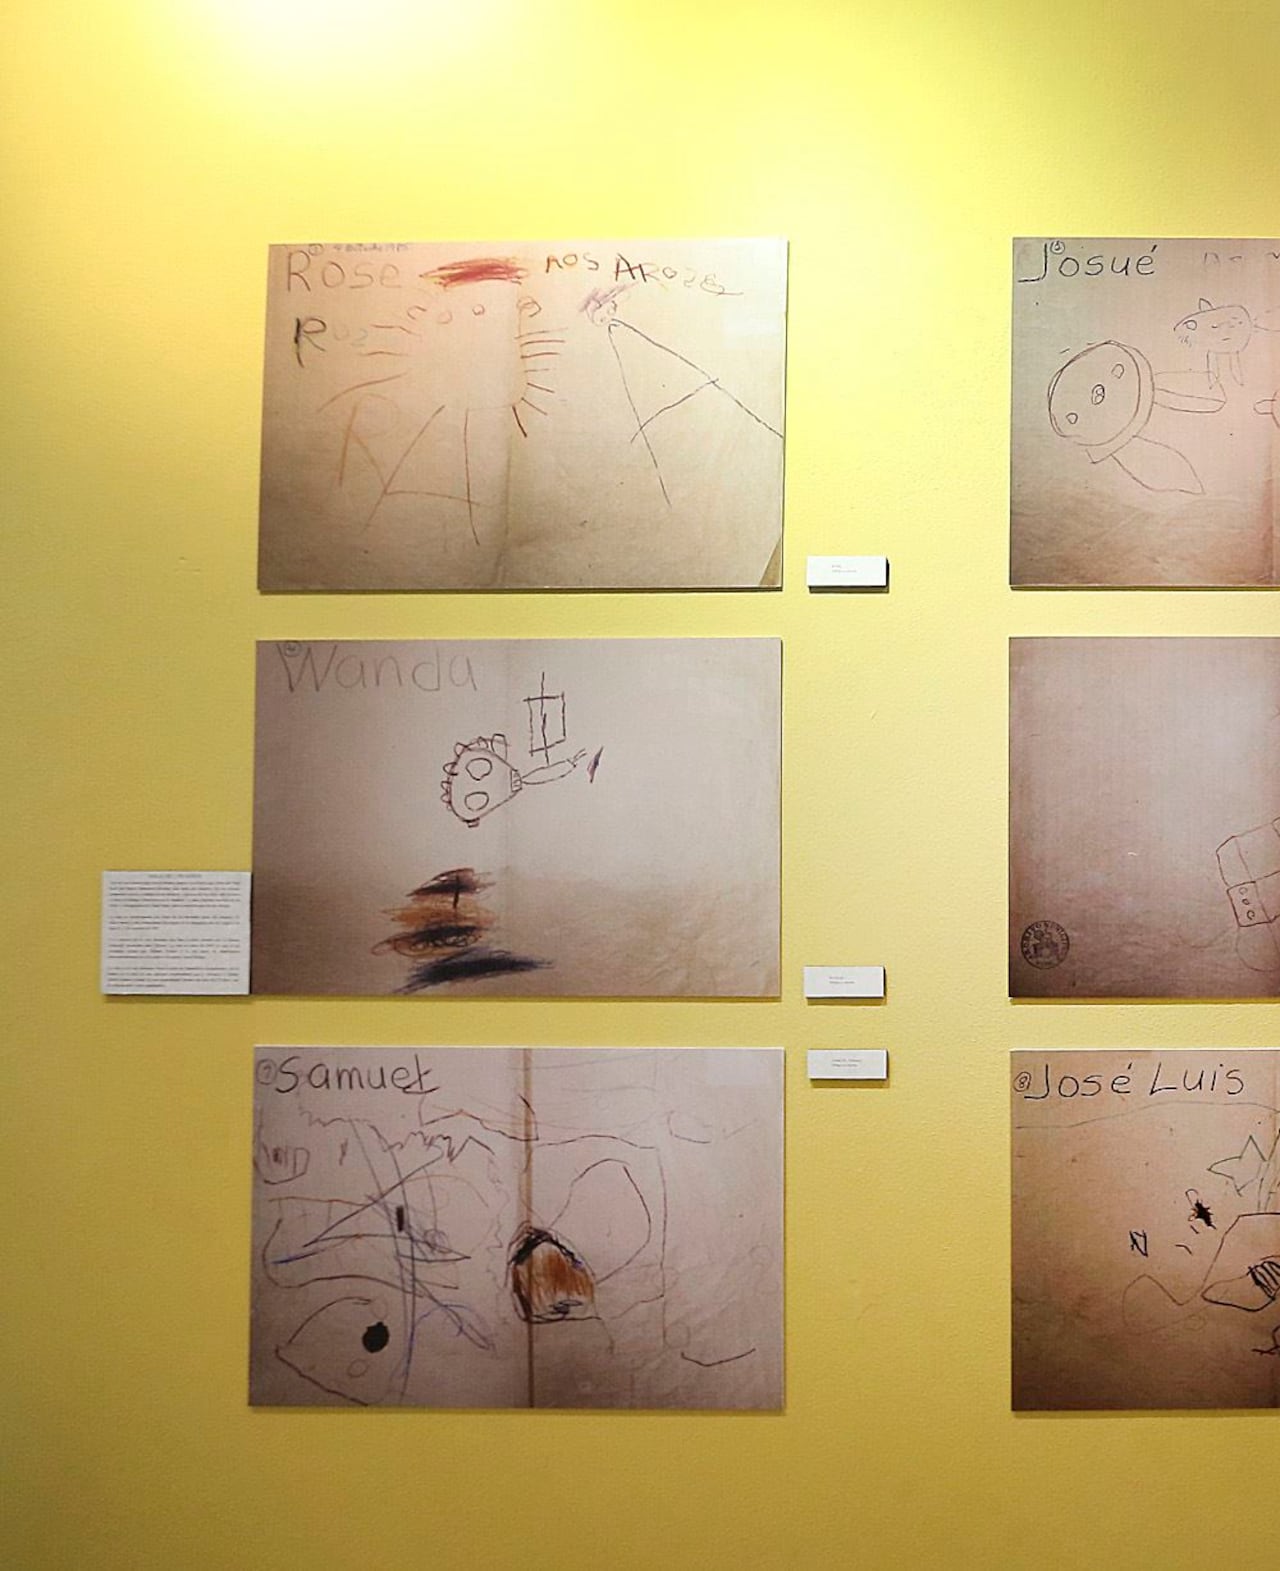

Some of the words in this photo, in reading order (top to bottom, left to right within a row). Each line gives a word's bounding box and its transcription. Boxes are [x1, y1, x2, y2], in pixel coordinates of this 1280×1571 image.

[1018, 242, 1158, 283] Josué
[276, 643, 478, 693] Wanda
[1024, 1062, 1134, 1100] José
[1149, 1061, 1245, 1096] Luis
